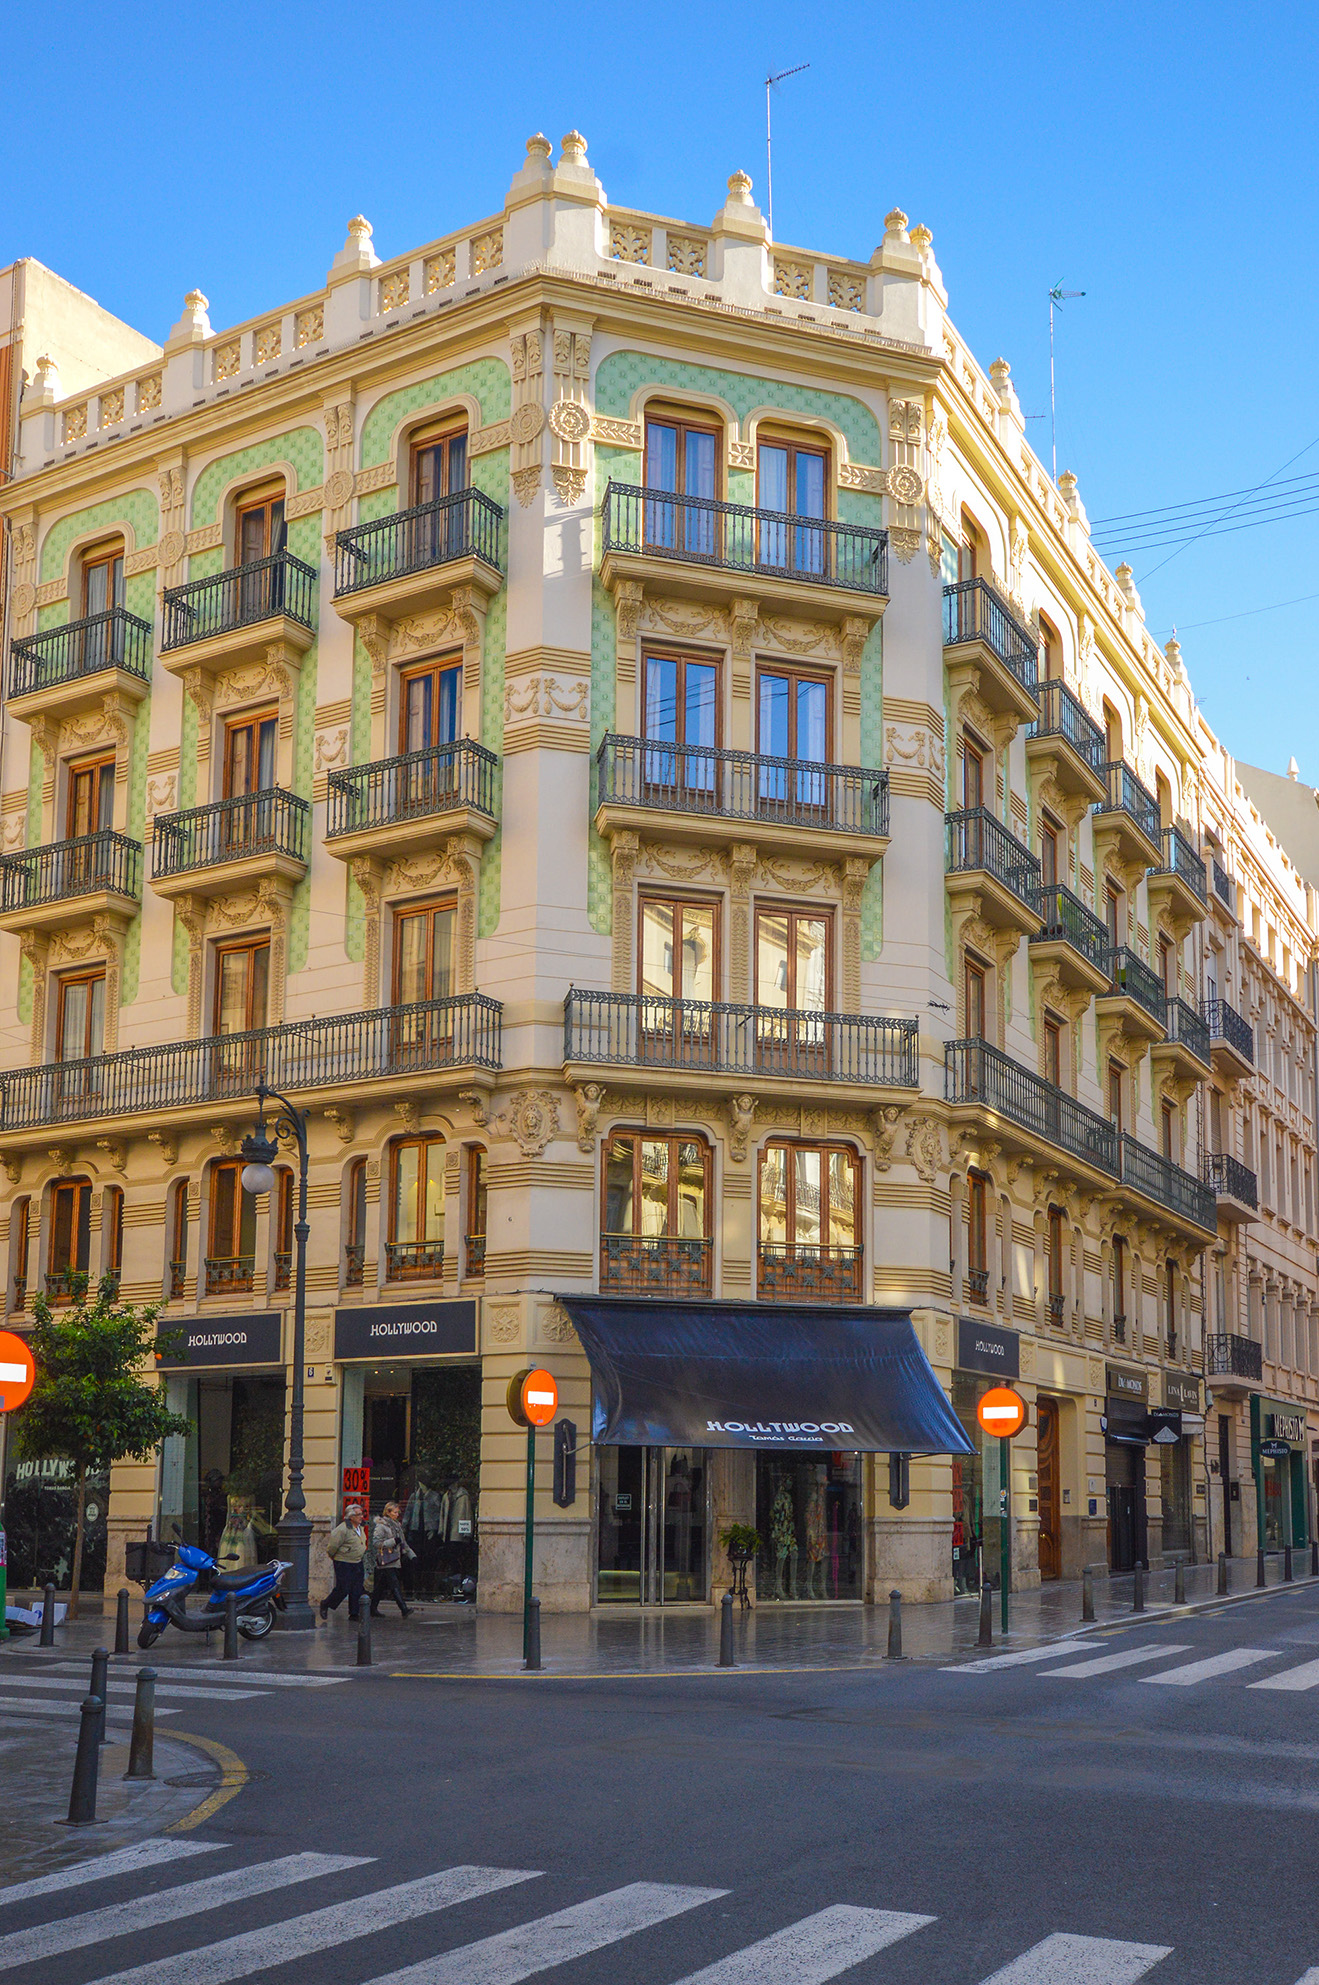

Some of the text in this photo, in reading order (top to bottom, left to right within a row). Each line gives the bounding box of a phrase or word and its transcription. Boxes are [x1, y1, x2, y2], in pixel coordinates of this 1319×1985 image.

[370, 1321, 437, 1336] HOLLYWOOD
[188, 1332, 247, 1347] HOLLYWOOD
[975, 1340, 1005, 1356] HOLLYWOOD
[344, 1469, 368, 1490] 30%
